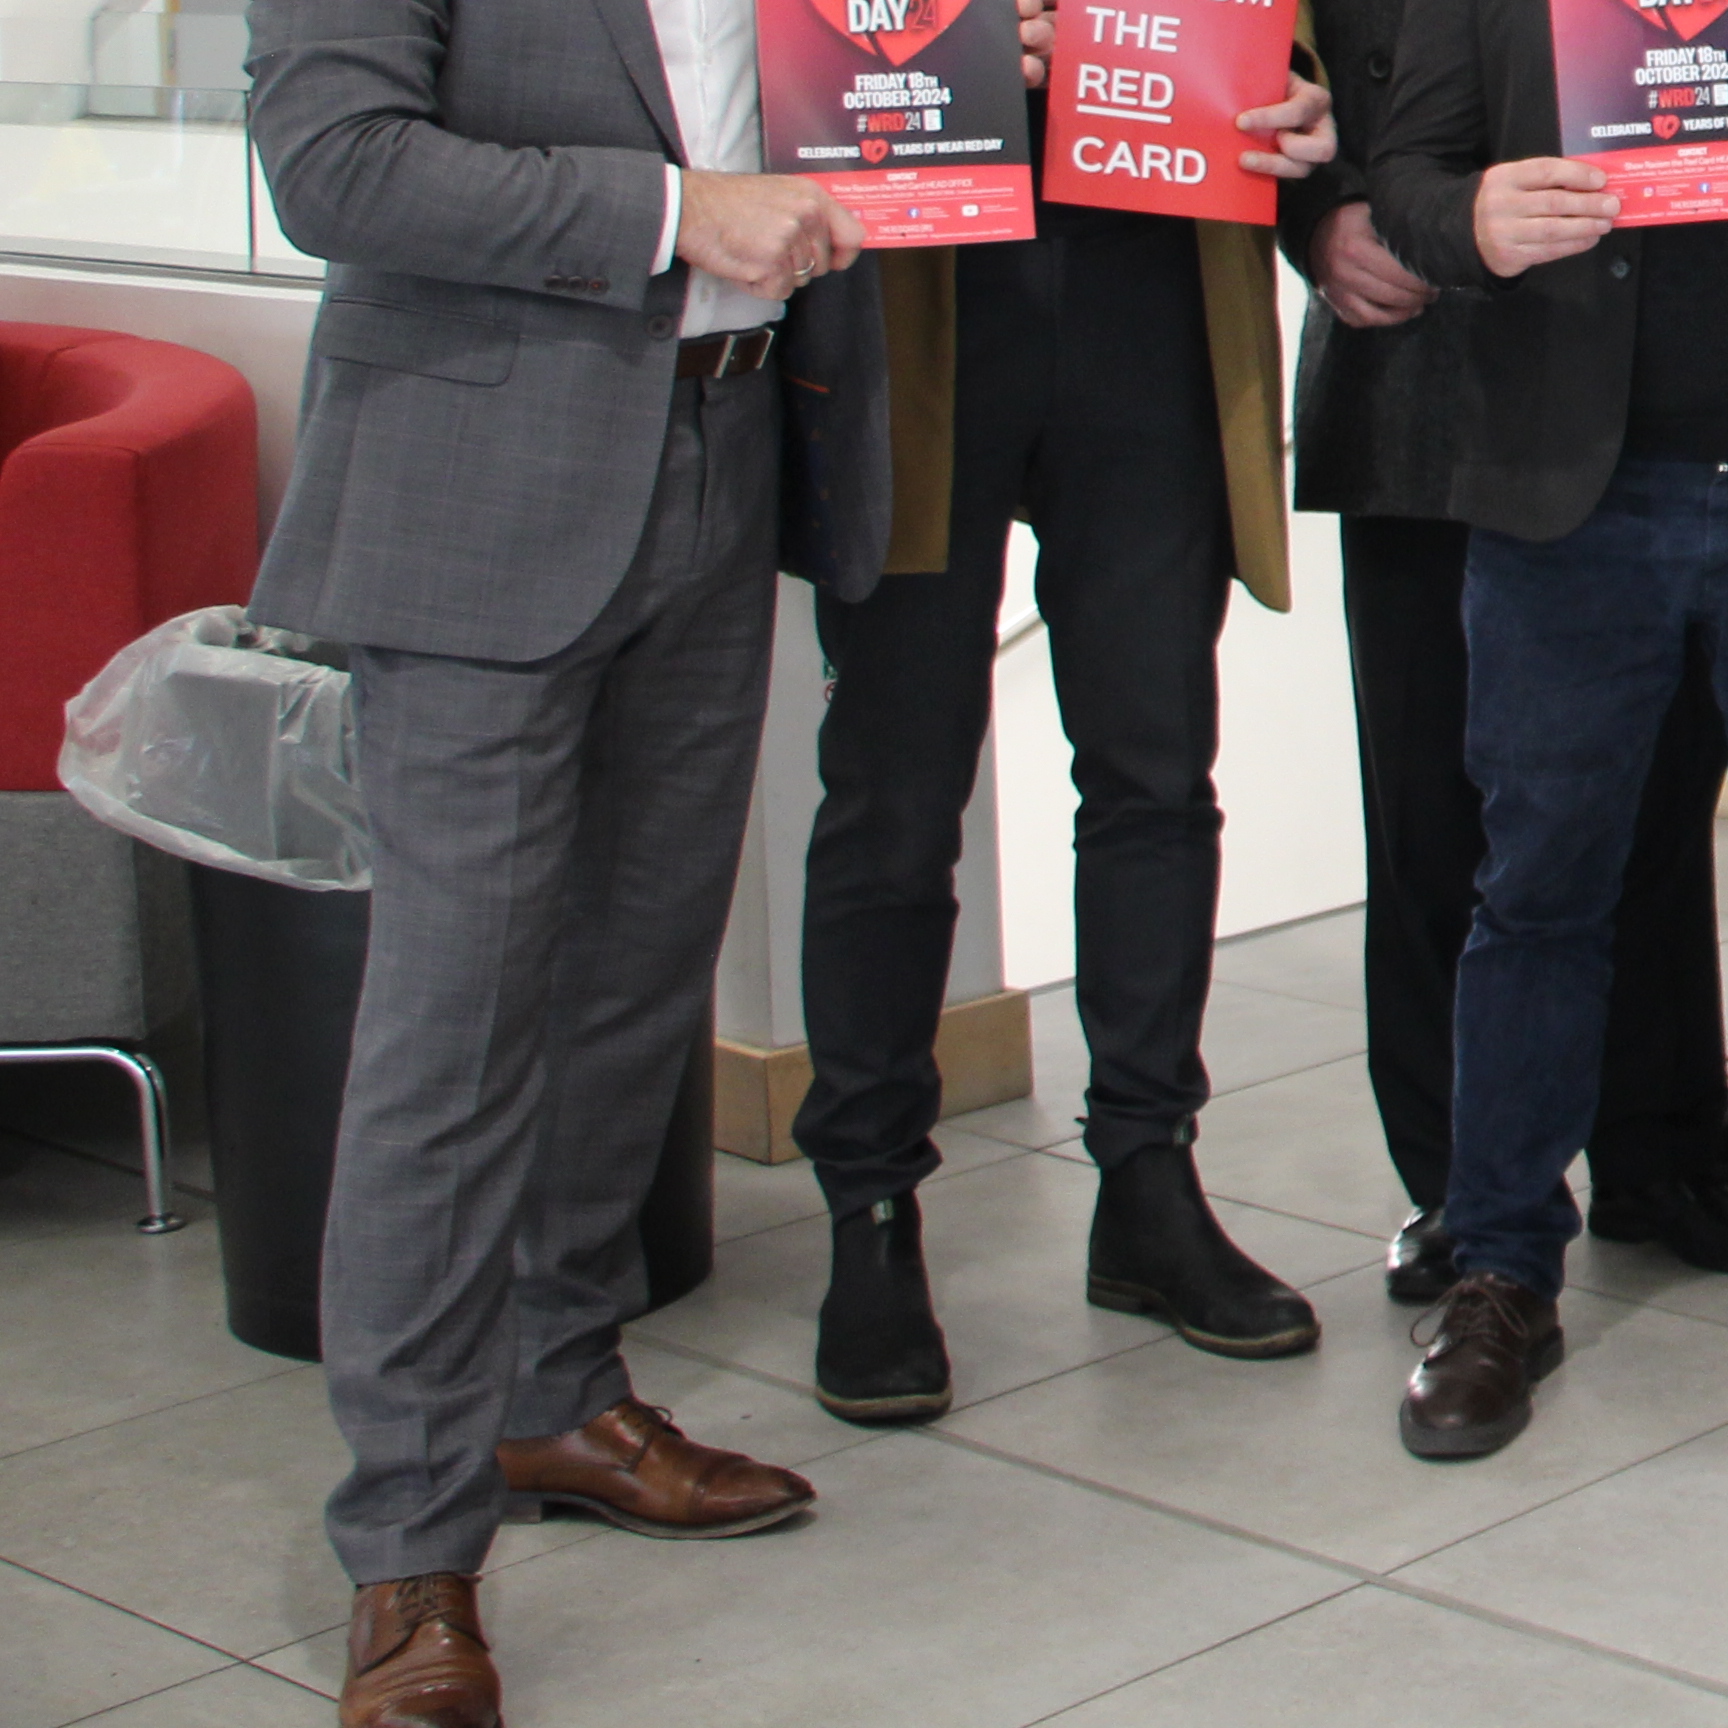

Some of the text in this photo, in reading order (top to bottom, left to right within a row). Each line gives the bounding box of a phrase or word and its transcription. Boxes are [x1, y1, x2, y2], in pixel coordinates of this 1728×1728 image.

[1085, 5, 1182, 54] THE
[1646, 46, 1727, 67] FRIDAY 18TH
[855, 72, 938, 91] FRIDAY 18TH
[1635, 66, 1700, 85] OCTOBER
[1077, 64, 1175, 111] RED
[1649, 87, 1711, 109] #WRD24
[843, 88, 952, 109] OCTOBER 2024
[1591, 122, 1652, 138] CELEBRATING
[1683, 117, 1713, 132] YEARS
[797, 145, 861, 160] CELEBRATING
[892, 143, 923, 156] YEARS
[937, 141, 964, 153] WEAR
[983, 139, 1004, 151] DAY
[1071, 135, 1208, 188] CARD
